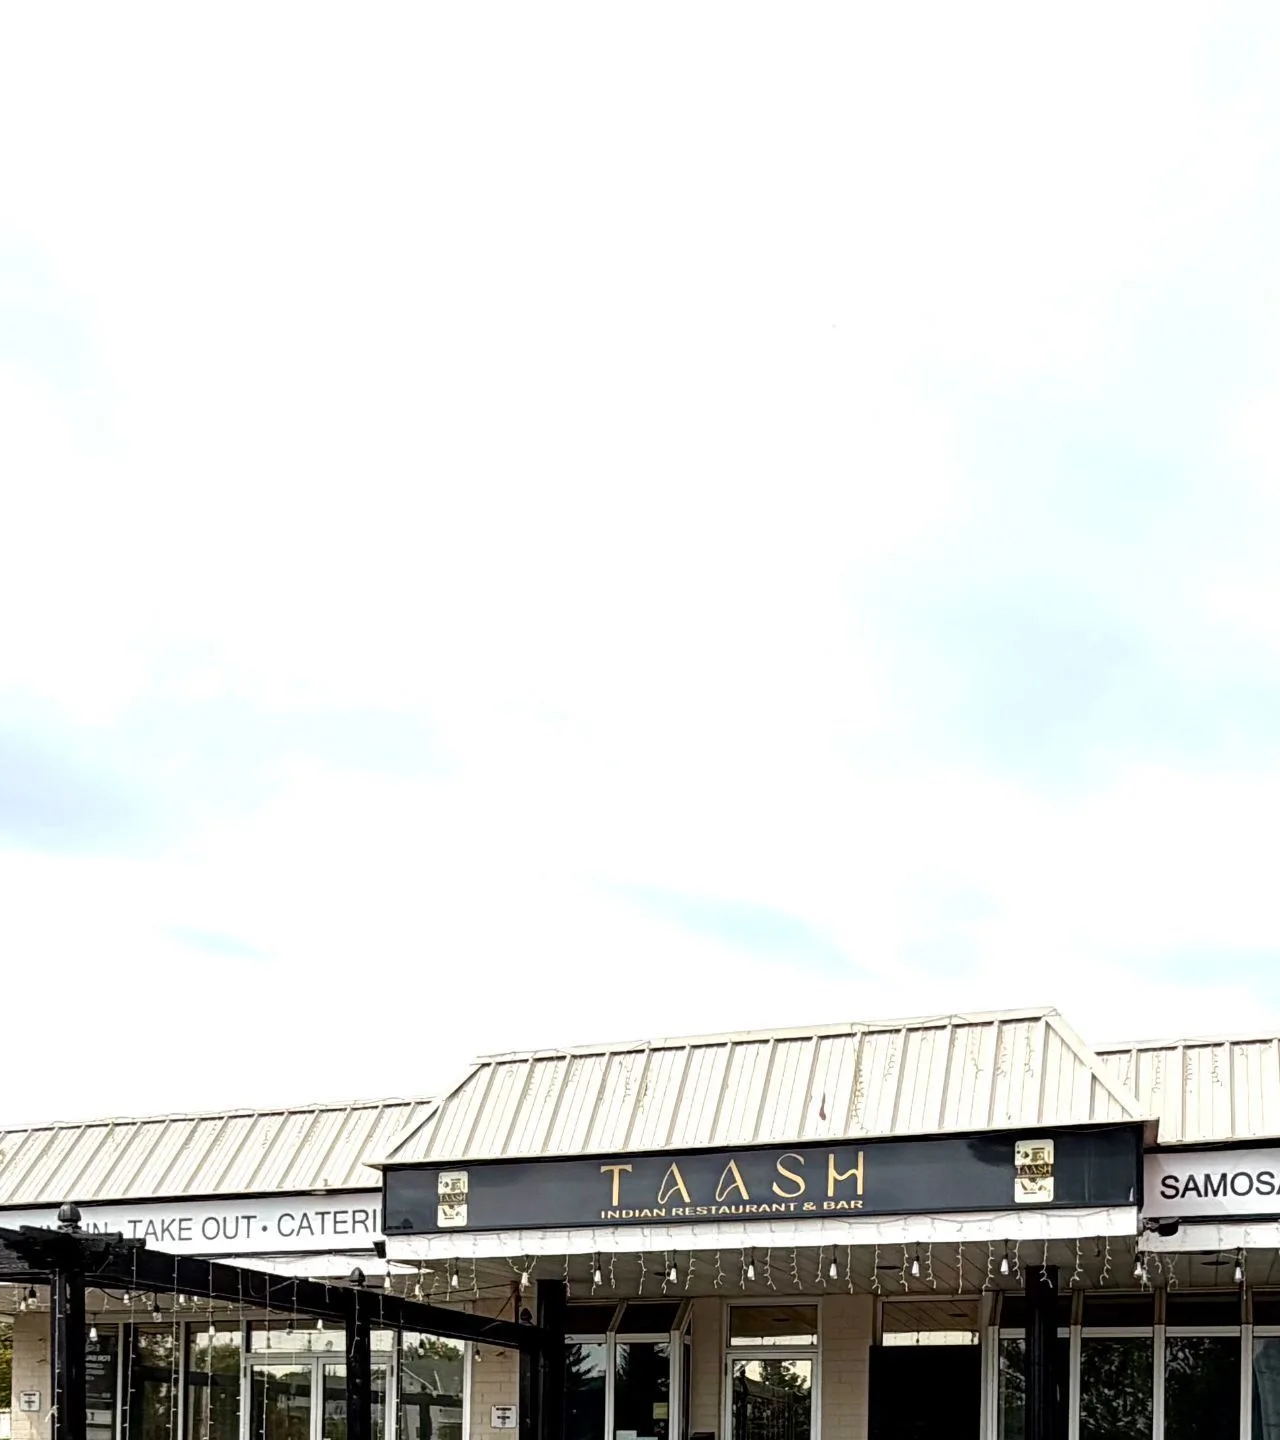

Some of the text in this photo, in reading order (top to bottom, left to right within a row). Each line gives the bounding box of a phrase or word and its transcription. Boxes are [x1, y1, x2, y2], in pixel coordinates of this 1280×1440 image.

[600, 1151, 864, 1206] TAASH
[127, 1217, 193, 1242] TAKE
[201, 1215, 257, 1240] OUT
[277, 1208, 377, 1237] CATERI
[601, 1200, 863, 1219] INDIAN RESTAURANT & BAR
